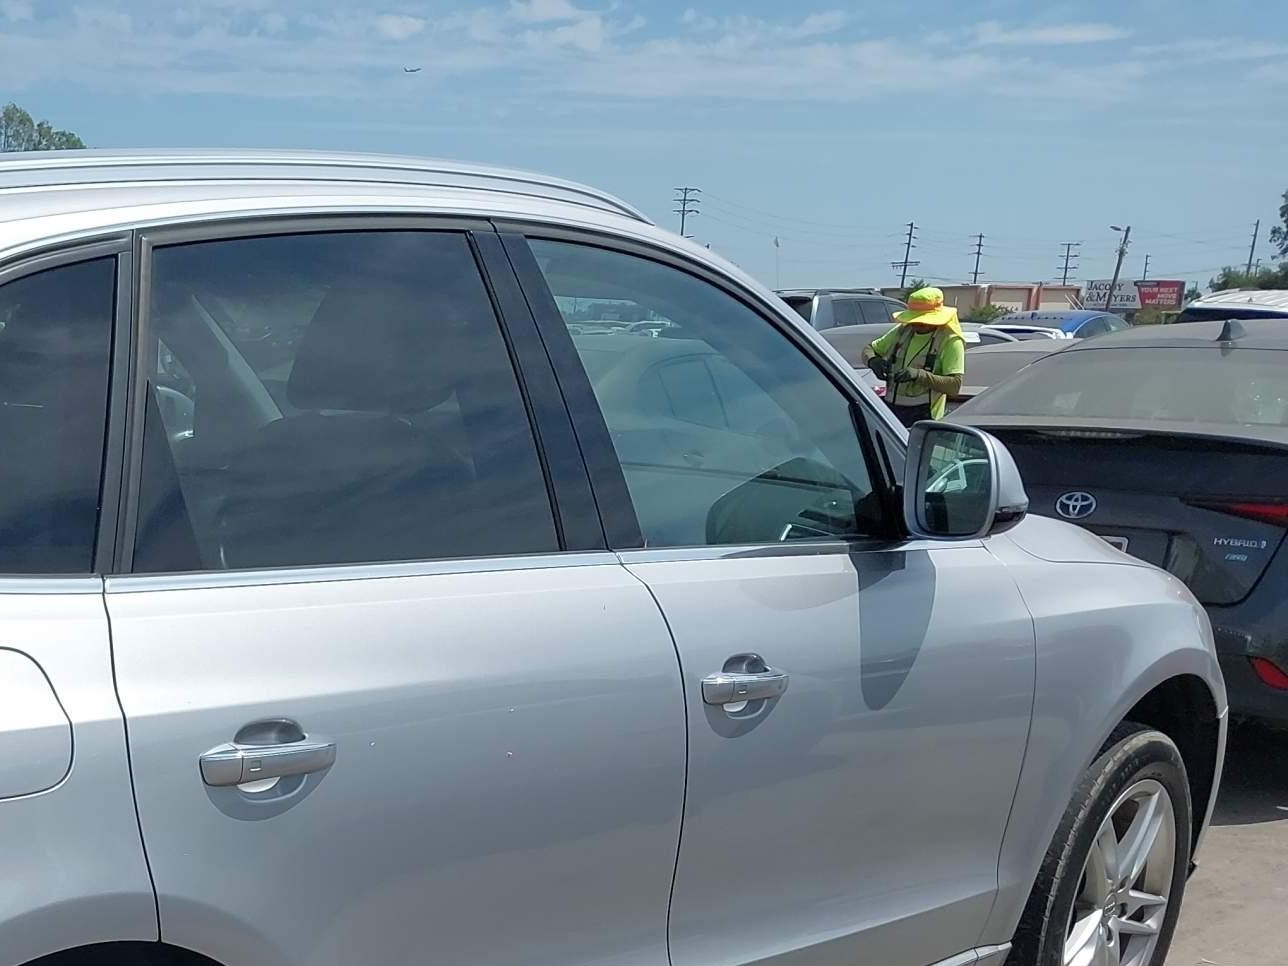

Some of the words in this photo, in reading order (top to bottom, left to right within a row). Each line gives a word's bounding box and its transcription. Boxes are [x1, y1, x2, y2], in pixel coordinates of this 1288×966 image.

[1087, 280, 1124, 291] JACOY
[1086, 291, 1137, 303] &MYERS
[1213, 537, 1257, 548] HYBRID
